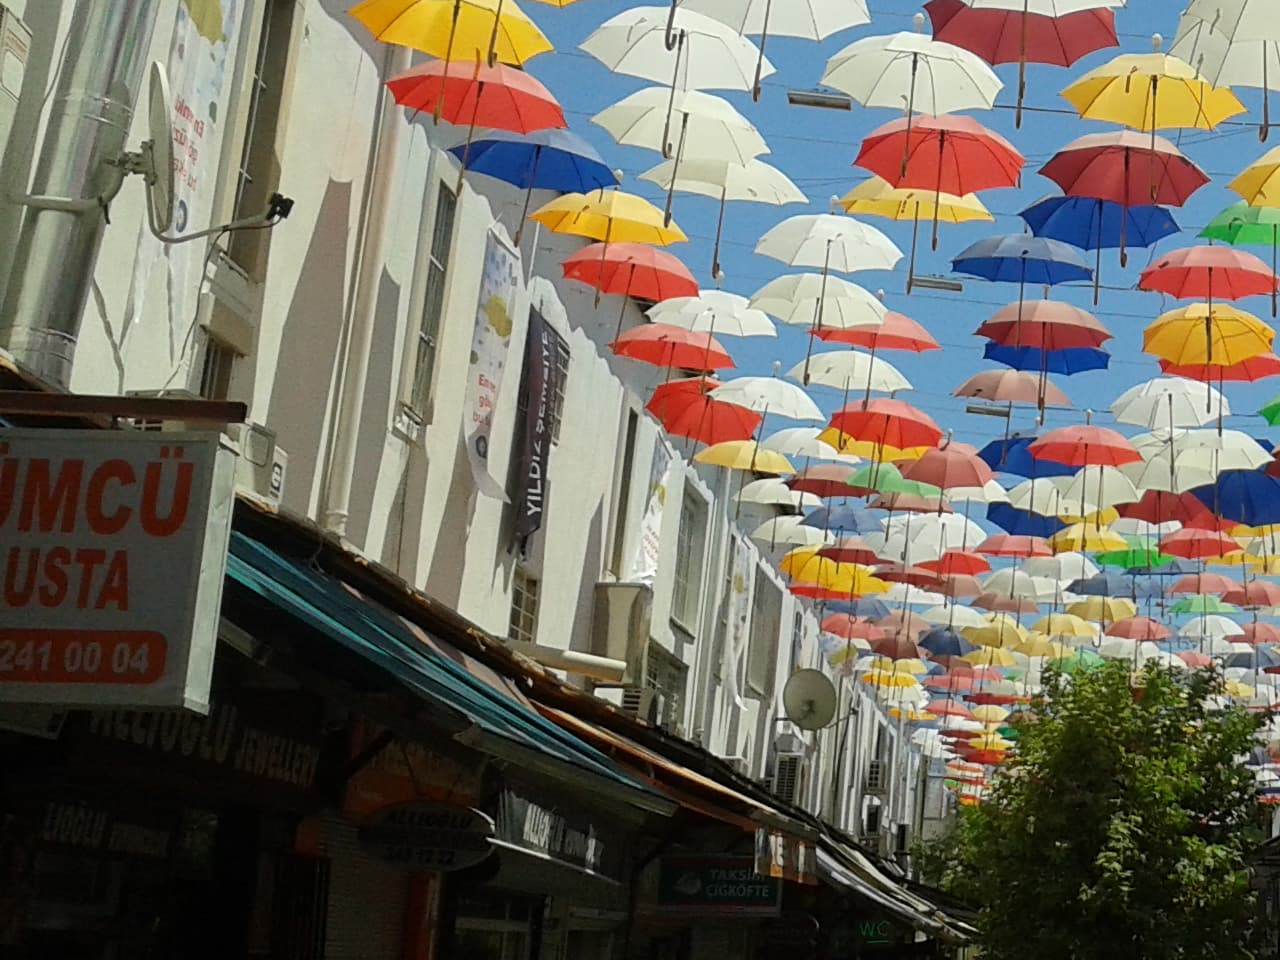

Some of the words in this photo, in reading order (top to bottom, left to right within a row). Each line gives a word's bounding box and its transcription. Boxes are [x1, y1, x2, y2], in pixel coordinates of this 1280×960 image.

[527, 439, 543, 517] YILDIZ
[4, 546, 129, 611] USTA
[0, 642, 51, 672] 241
[64, 642, 100, 673] 00
[112, 643, 149, 674] 04
[858, 919, 889, 937] WC
